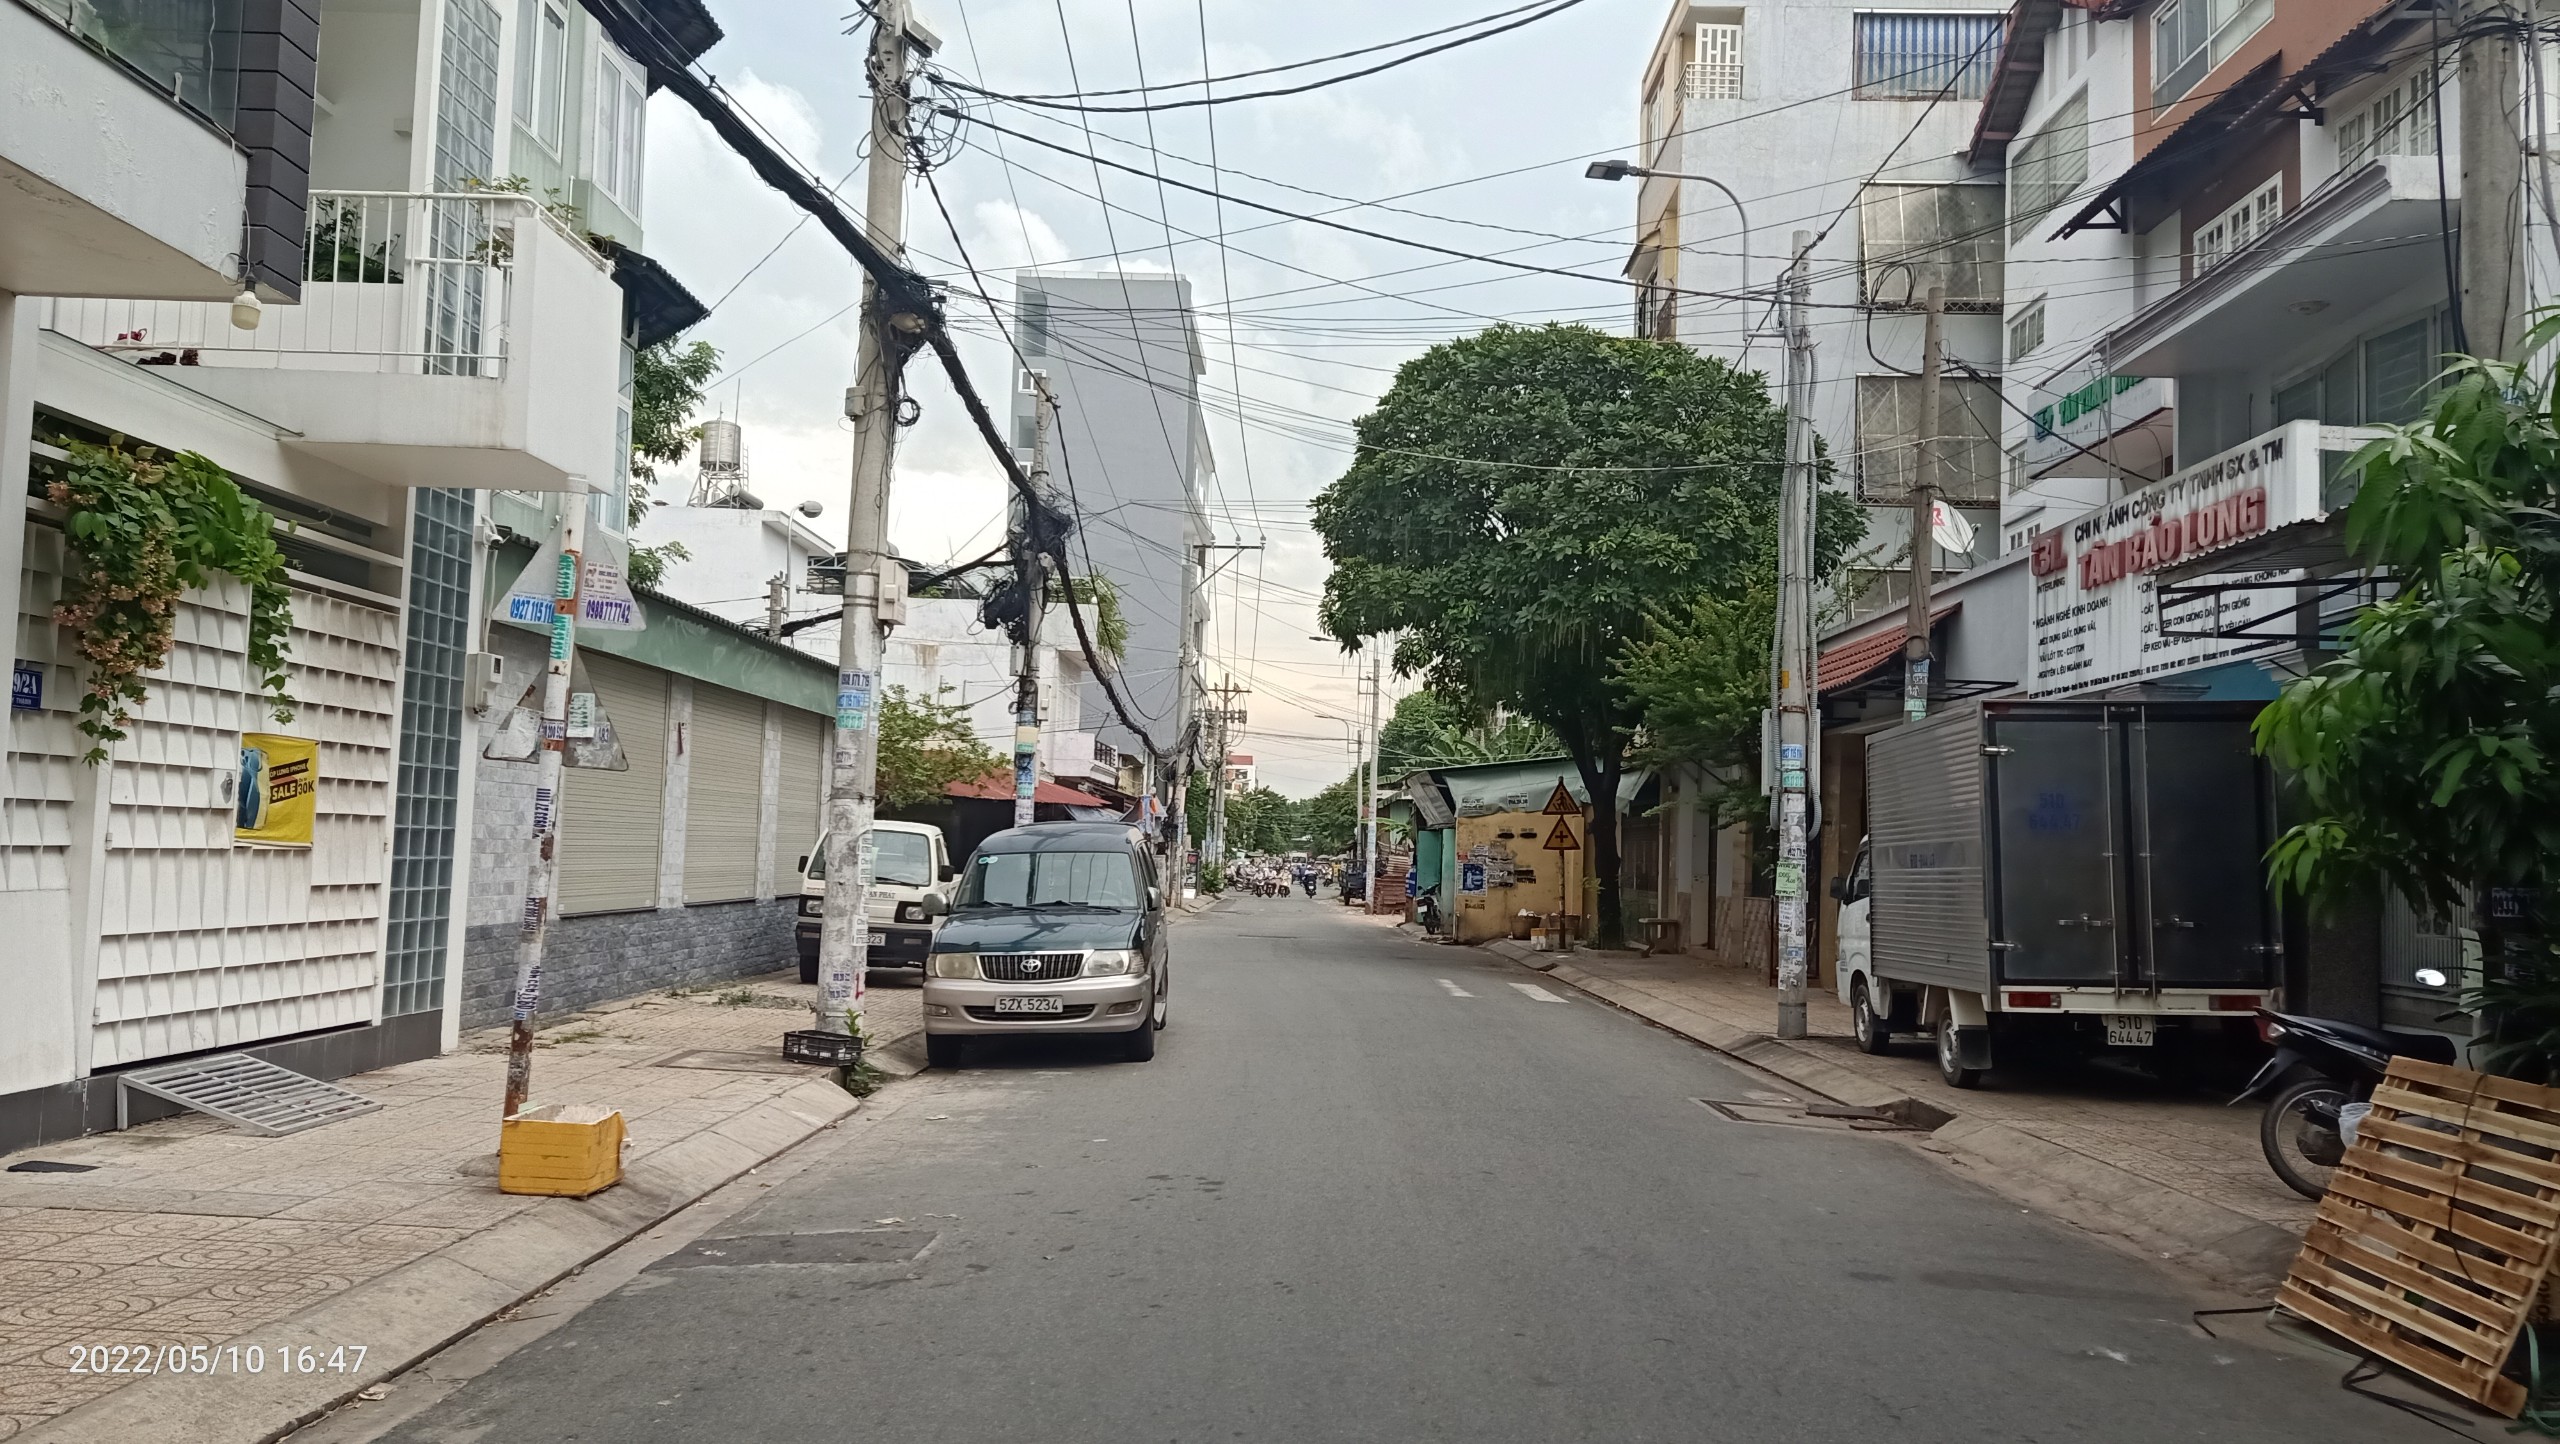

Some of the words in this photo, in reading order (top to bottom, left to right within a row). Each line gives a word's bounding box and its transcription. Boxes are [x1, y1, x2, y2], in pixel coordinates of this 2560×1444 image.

[2093, 505, 2128, 537] NÁNH
[2132, 486, 2165, 523] CÔNG
[2168, 480, 2186, 505] TY
[2189, 466, 2223, 495] TNHH
[2227, 453, 2246, 480] SX
[2249, 448, 2259, 471] &
[2262, 440, 2283, 466] TM
[2078, 538, 2127, 590] TÂN
[2126, 512, 2182, 574] BẢO
[2184, 487, 2266, 554] LONG
[272, 783, 297, 800] SALE
[298, 780, 315, 796] 30K
[2118, 1016, 2142, 1030] 51D
[2110, 1031, 2152, 1045] 644.47
